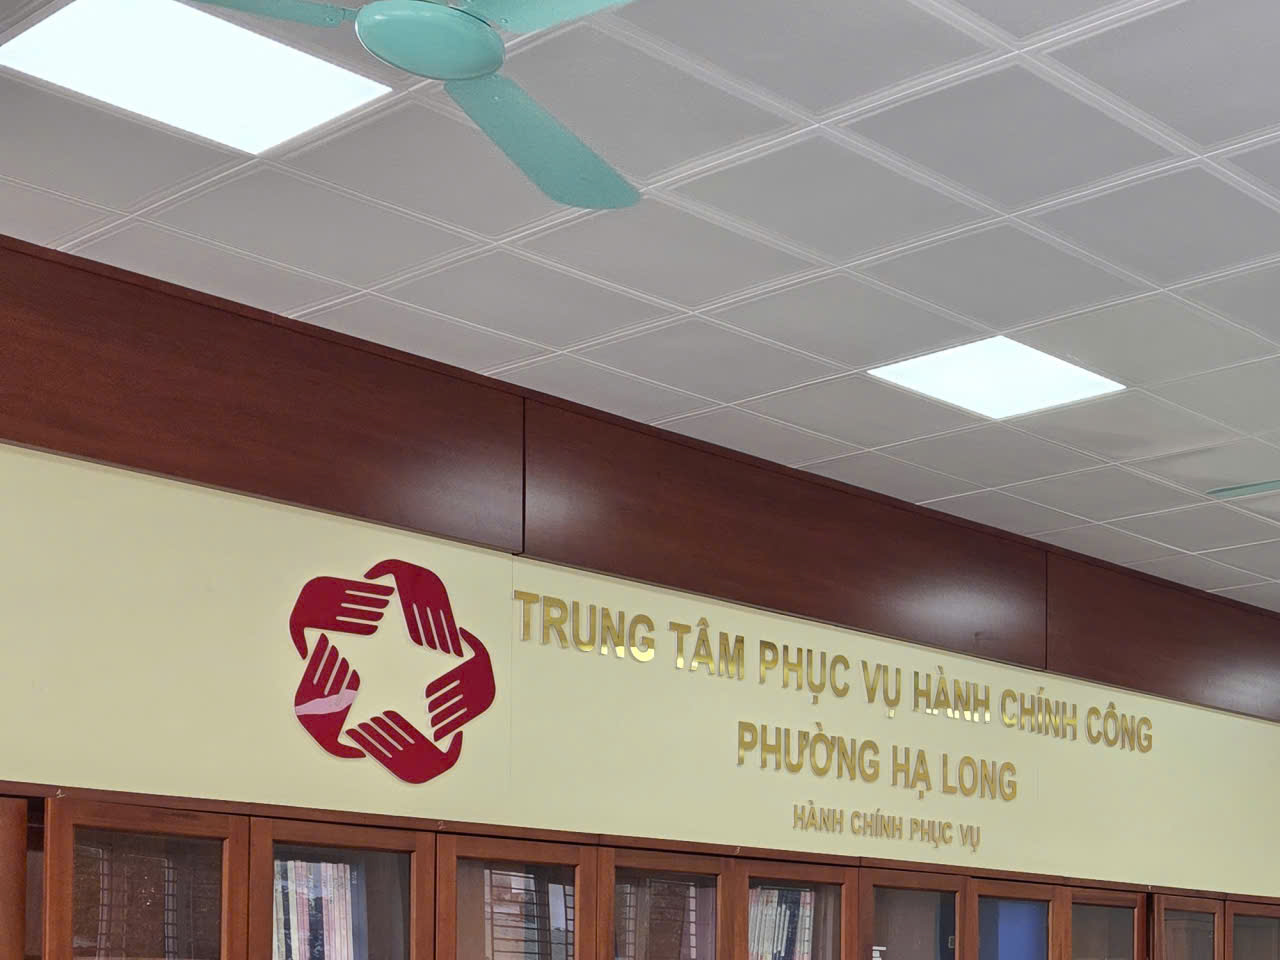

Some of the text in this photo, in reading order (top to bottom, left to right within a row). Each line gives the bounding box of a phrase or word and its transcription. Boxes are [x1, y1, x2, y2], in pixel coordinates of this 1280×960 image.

[513, 589, 1153, 754] TRUNG TÂM PHỤC VỤ HÀNH CHÍNH CÔNG
[736, 721, 1017, 802] PHƯỜNG HẠ LONG
[793, 800, 981, 852] HÀNH CHÍNH PHỤC VỤ
